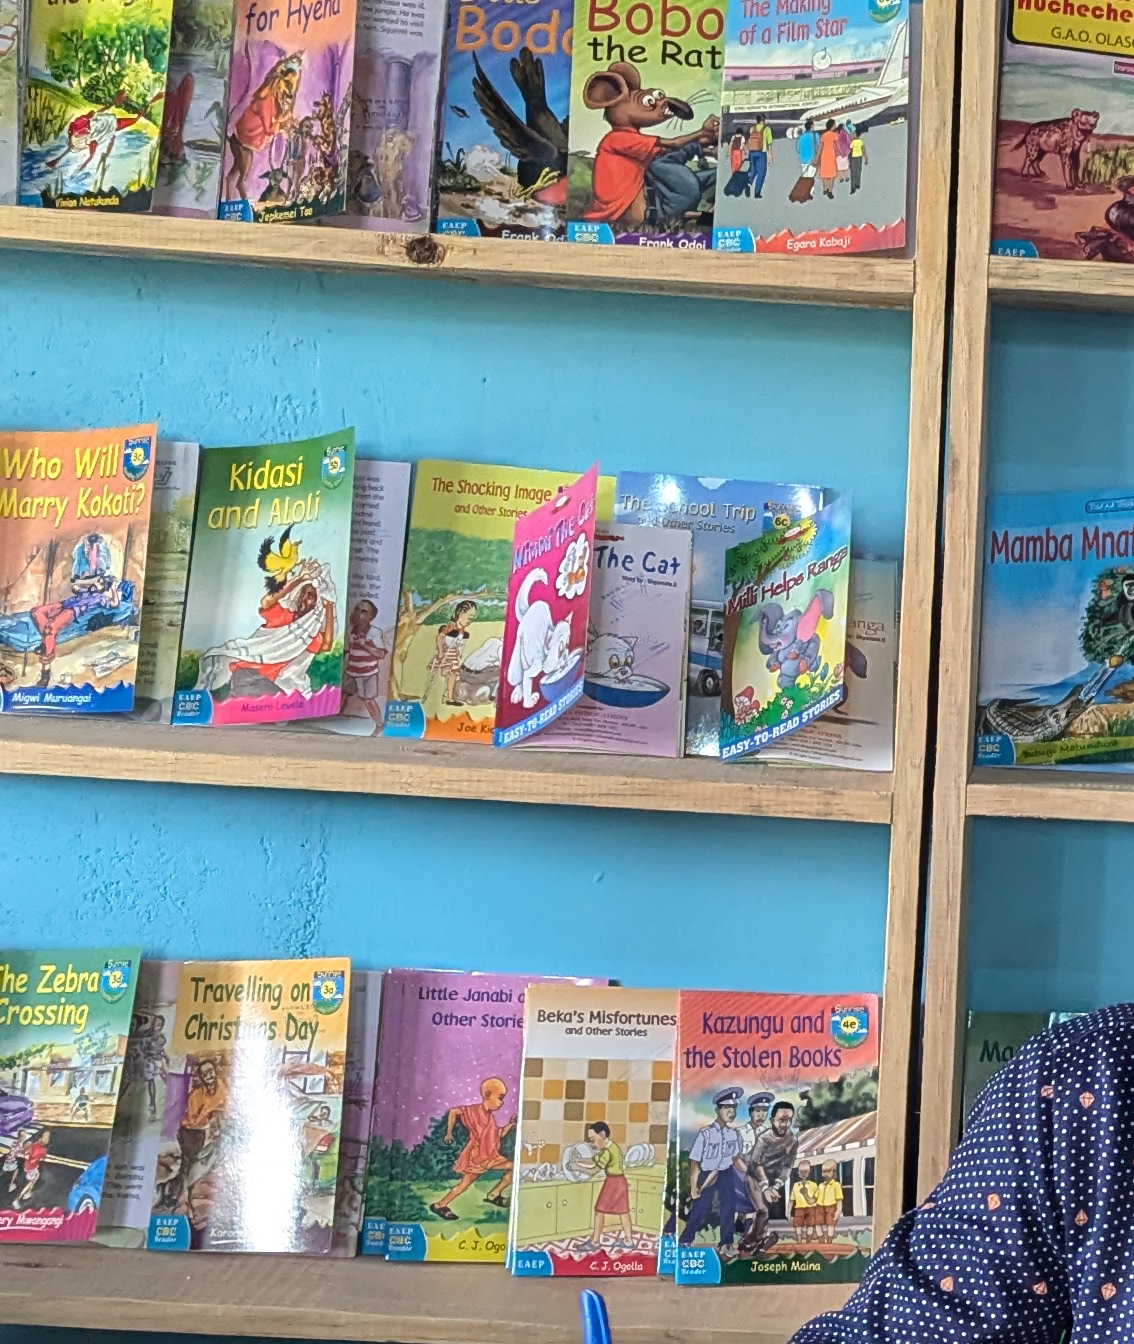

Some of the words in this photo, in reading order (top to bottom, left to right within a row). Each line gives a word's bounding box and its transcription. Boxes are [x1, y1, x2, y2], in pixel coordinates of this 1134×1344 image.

[245, 1, 277, 35] for
[739, 26, 756, 46] of
[760, 29, 771, 45] a
[776, 20, 812, 42] Film
[815, 16, 847, 40] Star
[1051, 27, 1092, 44] G.A.O.
[588, 36, 648, 64] the
[661, 39, 722, 70] Rat
[786, 238, 815, 251] Egara
[819, 236, 851, 251] Kabaji
[2, 447, 61, 481] Who
[74, 444, 120, 479] Will
[229, 457, 304, 491] Kidasi
[432, 476, 454, 494] The
[458, 479, 511, 502] Shocking
[514, 483, 552, 503] Image
[0, 489, 66, 528] Marry
[76, 483, 145, 519] Kokoti?
[207, 504, 258, 531] and
[268, 491, 321, 526] Aloli
[455, 503, 472, 517] and
[475, 504, 497, 518] Other
[498, 505, 527, 519] Stories
[991, 529, 1072, 564] Mamba
[728, 585, 759, 614] Milli
[762, 568, 804, 600] Helps
[807, 547, 849, 582] Ranga
[721, 711, 800, 759] EASY-TO-READ
[800, 690, 840, 726] STORIES
[190, 976, 281, 1010] Travelling
[291, 982, 310, 1002] on
[286, 1016, 319, 1042] Day
[537, 1008, 585, 1025] Beka's
[589, 1009, 677, 1026] Misfortunes
[702, 1010, 784, 1040] Kazungu
[791, 1013, 824, 1034] and
[565, 1026, 582, 1037] and
[585, 1026, 611, 1038] Other
[615, 1026, 647, 1039] Stories
[684, 1050, 717, 1069] the
[722, 1046, 782, 1069] Stolen
[789, 1045, 842, 1069] Books
[751, 1261, 788, 1276] Joseph
[792, 1260, 821, 1273] Maina
